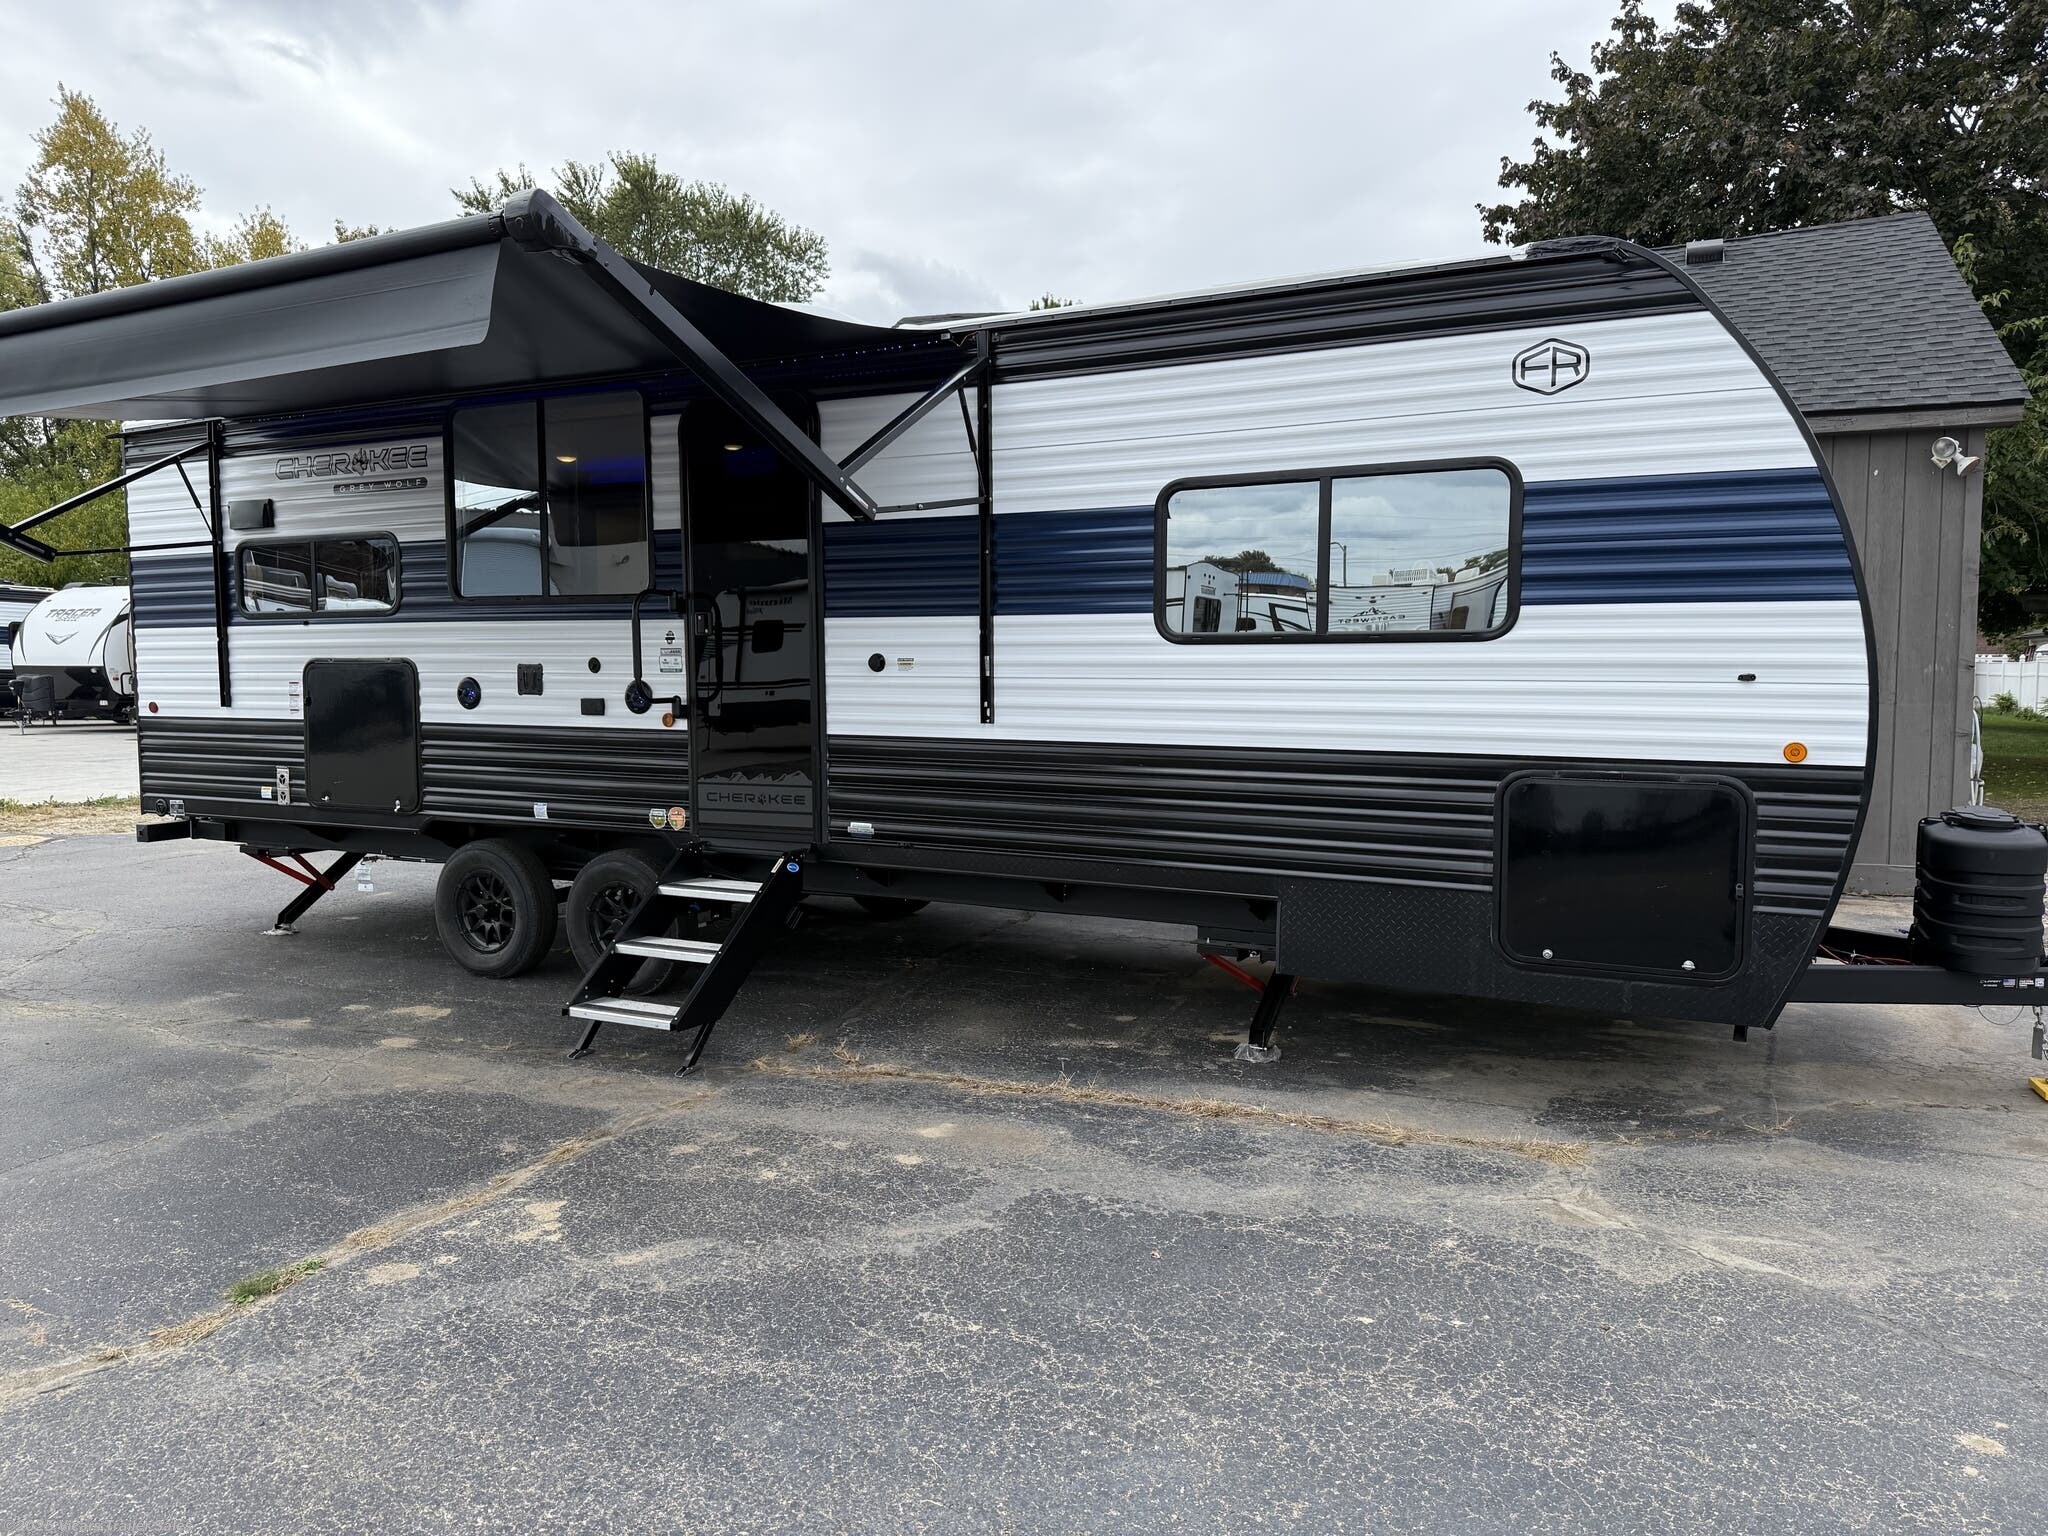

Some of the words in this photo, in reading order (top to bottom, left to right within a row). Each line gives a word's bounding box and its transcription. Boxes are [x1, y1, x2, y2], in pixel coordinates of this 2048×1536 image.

[339, 482, 375, 494] GREY
[384, 478, 426, 490] WOLF
[45, 607, 103, 618] TRACER
